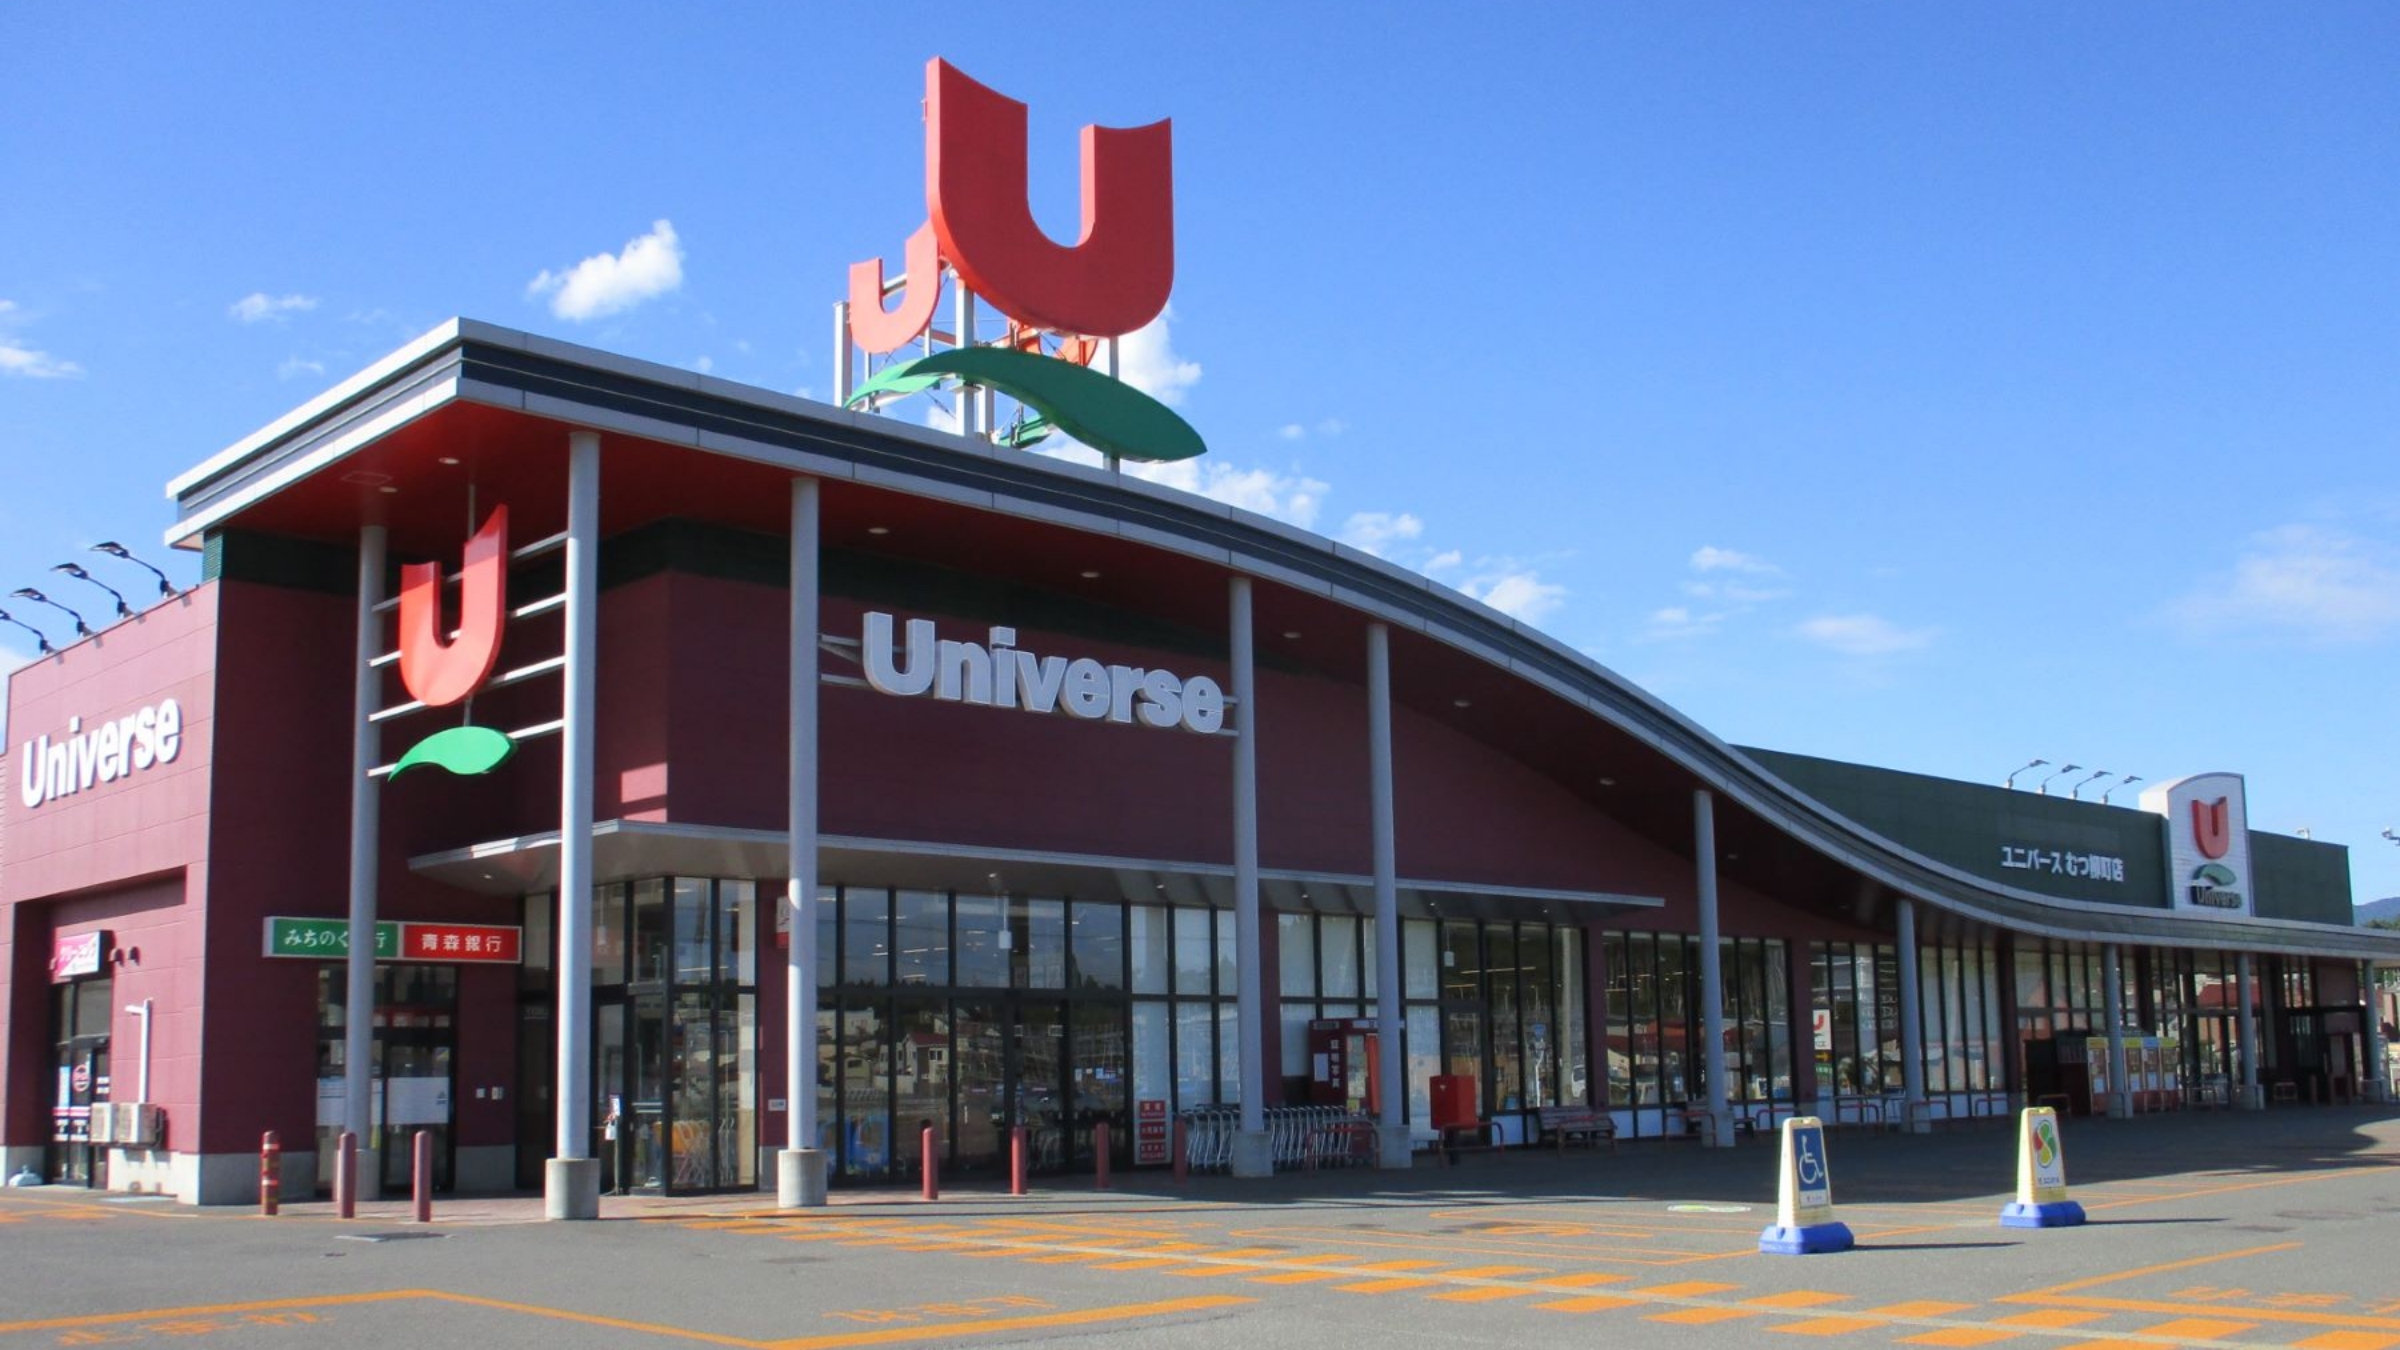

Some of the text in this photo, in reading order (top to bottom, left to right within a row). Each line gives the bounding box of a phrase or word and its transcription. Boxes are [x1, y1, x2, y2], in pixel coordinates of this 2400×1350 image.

[926, 56, 1174, 337] U
[399, 503, 508, 707] U
[863, 611, 1224, 733] Universe
[22, 698, 182, 809] Universe
[2001, 846, 2063, 874] ユニバース
[2191, 796, 2230, 859] U
[284, 929, 387, 949] みちのく行
[421, 933, 502, 953] 青森銀行
